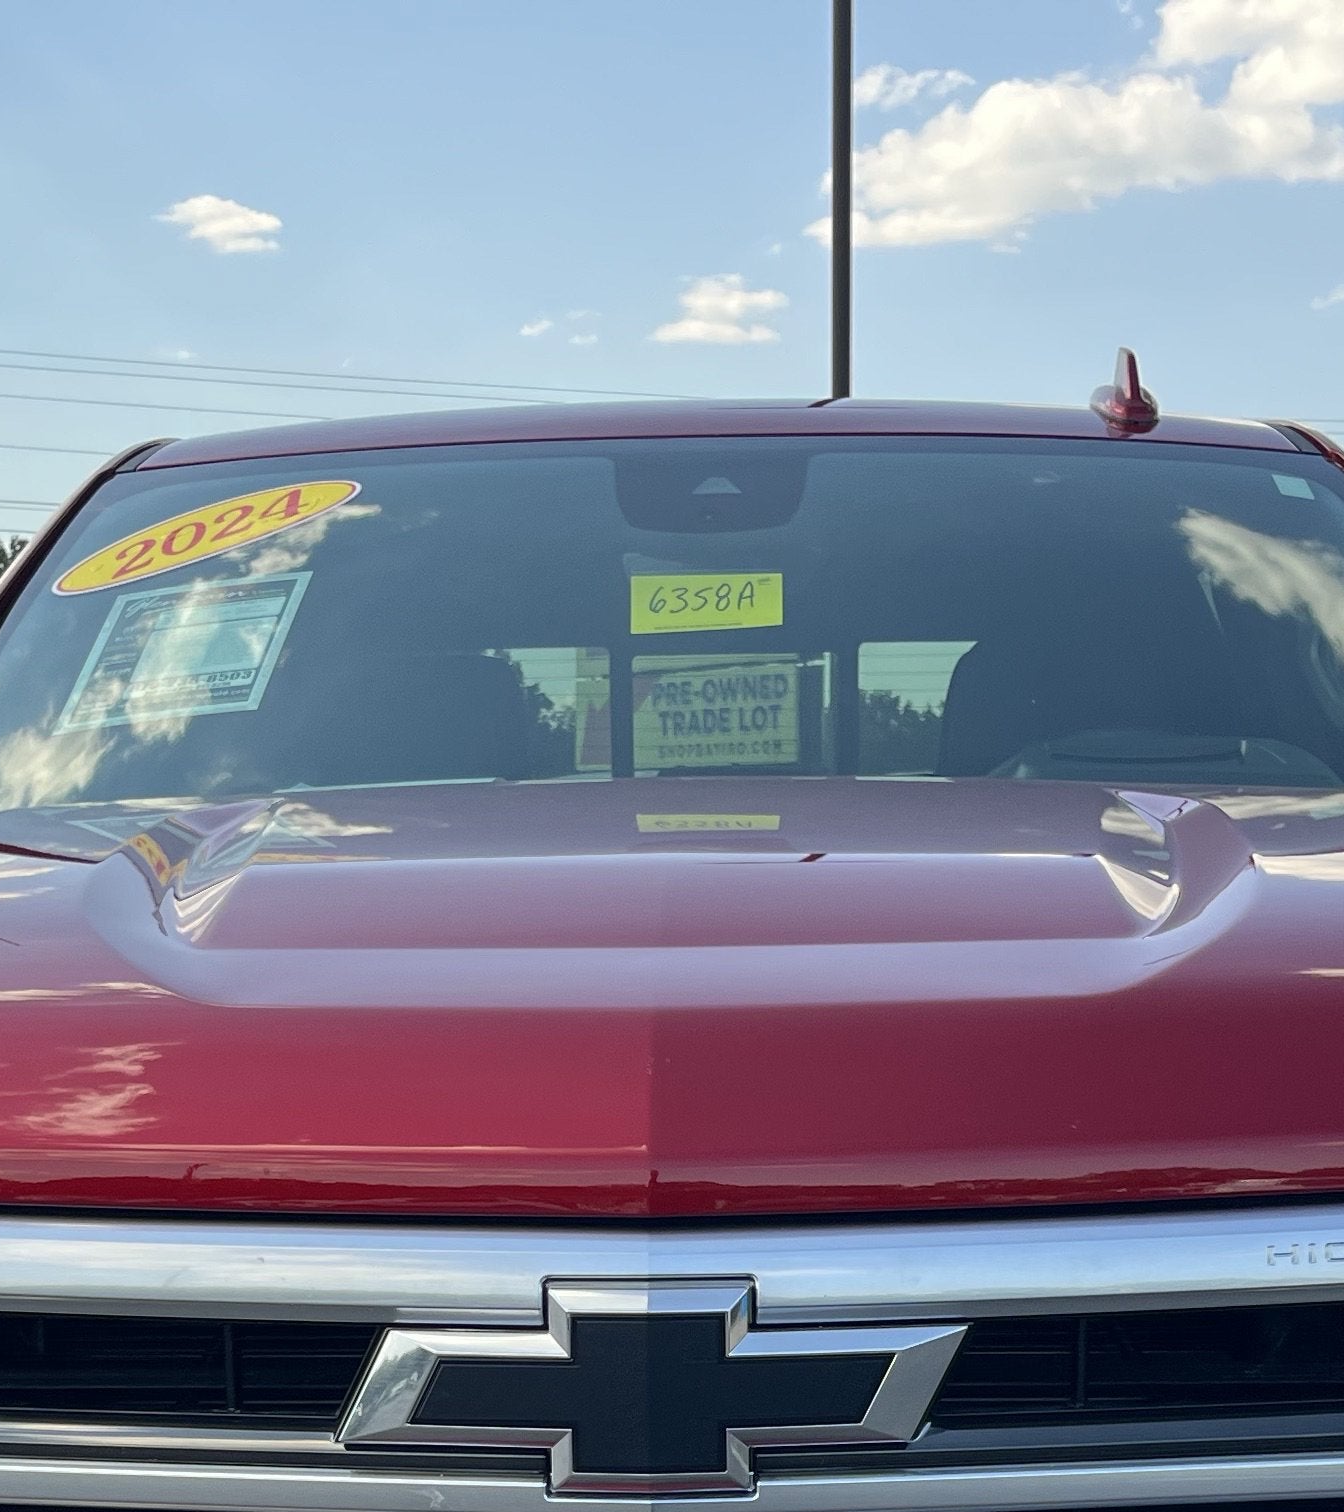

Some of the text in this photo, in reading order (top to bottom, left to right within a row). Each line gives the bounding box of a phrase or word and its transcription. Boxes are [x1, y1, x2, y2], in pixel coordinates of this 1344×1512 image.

[111, 488, 310, 580] 2024
[648, 580, 755, 614] 6358A
[651, 673, 788, 707] PRE-OWNED
[658, 704, 783, 737] TRADE LOT
